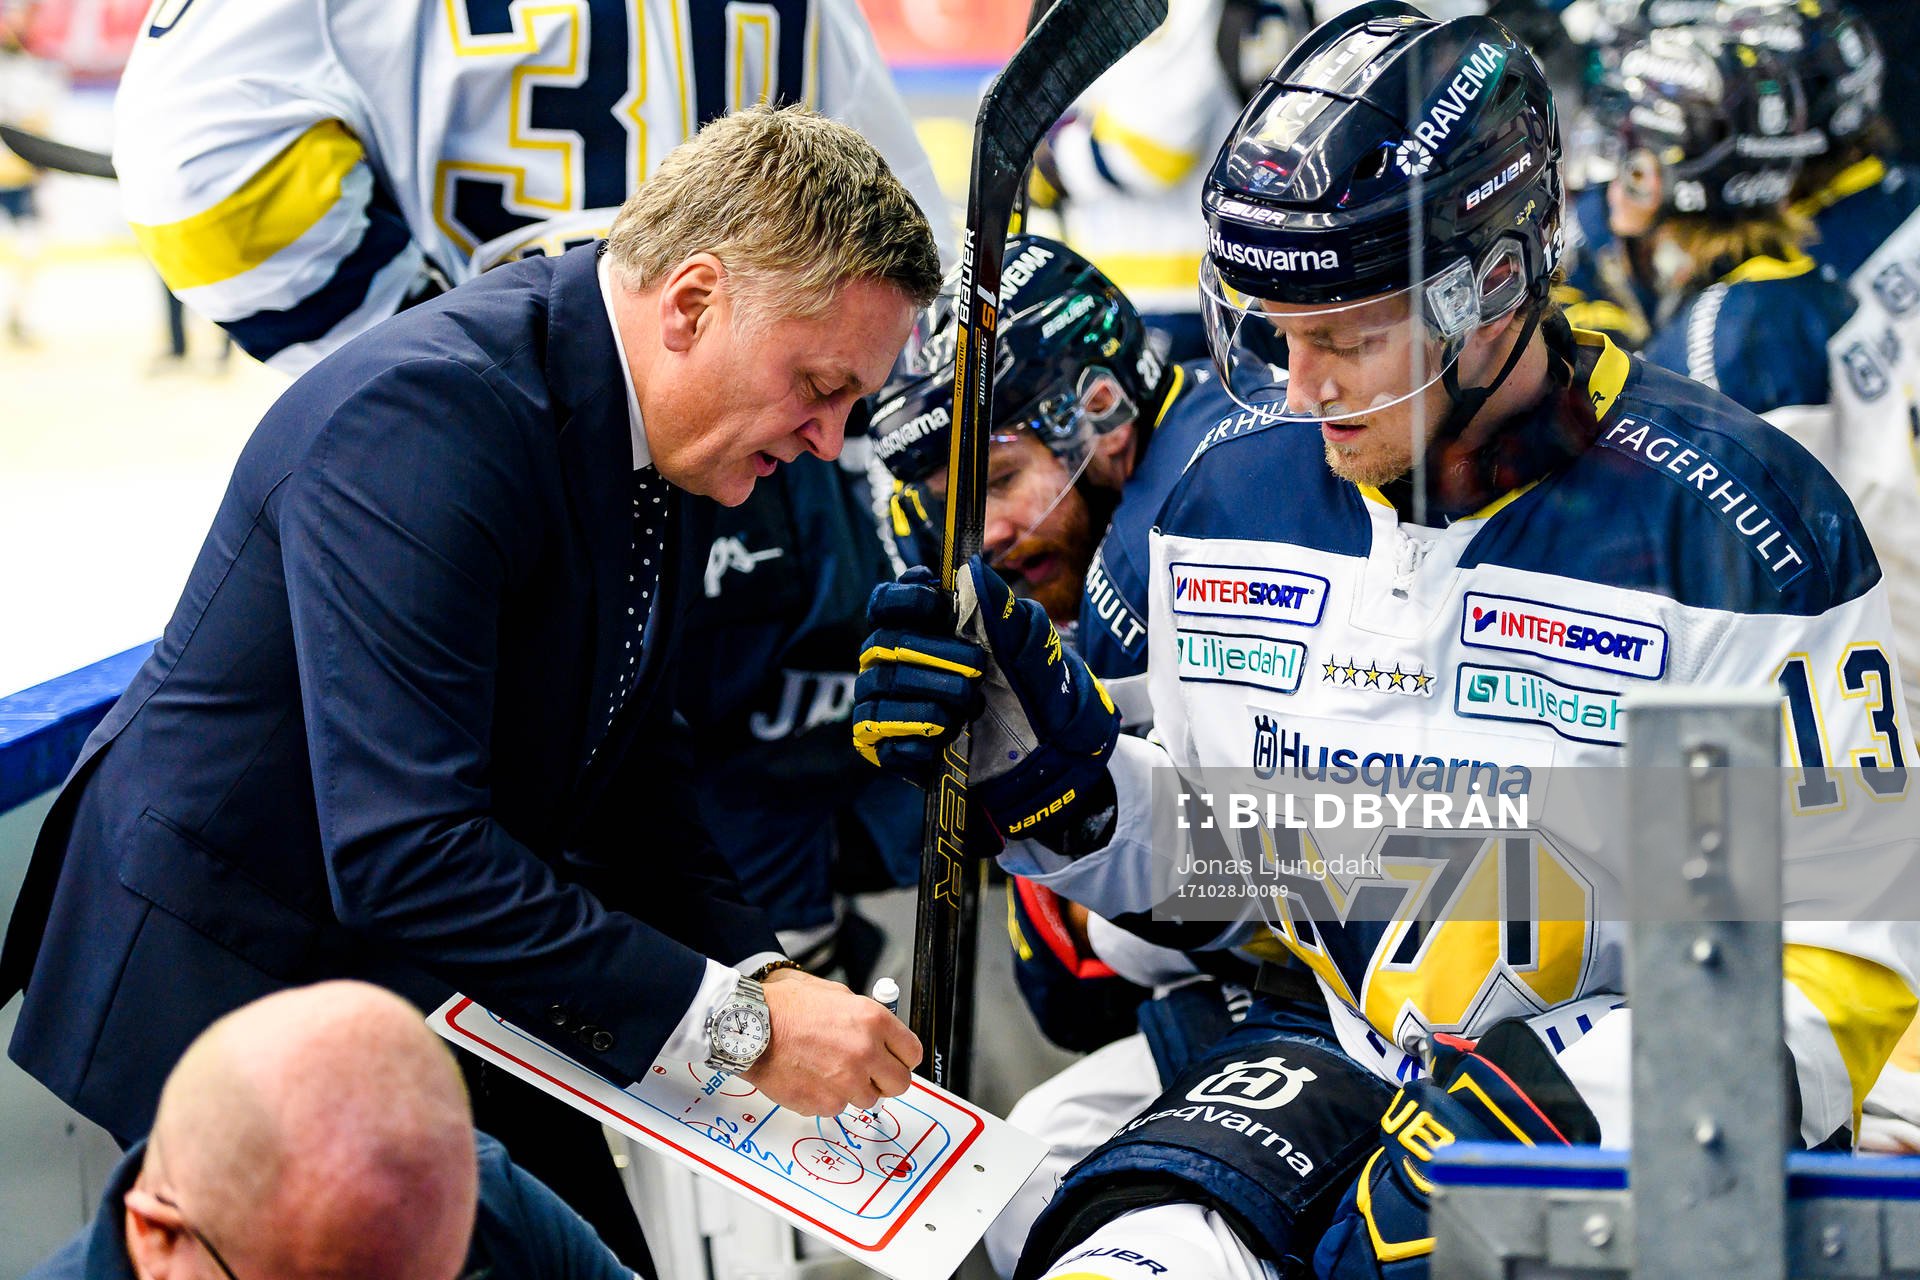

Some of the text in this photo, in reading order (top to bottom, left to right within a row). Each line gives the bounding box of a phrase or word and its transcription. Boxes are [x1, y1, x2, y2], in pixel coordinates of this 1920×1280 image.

[1414, 42, 1504, 151] RAVEMA
[1466, 152, 1532, 211] BAUER
[959, 228, 976, 325] BAUER
[1210, 230, 1339, 272] Husqvarna
[1605, 418, 1803, 572] FAGERHULT
[1188, 578, 1309, 610] INTERSPORT
[1188, 636, 1297, 678] Liljedahl
[1500, 611, 1648, 662] INTERSPORT
[1505, 674, 1629, 731] Liljedah
[1770, 640, 1911, 816] 13
[1280, 729, 1533, 800] Husqvarna
[1008, 788, 1076, 834] BAUER
